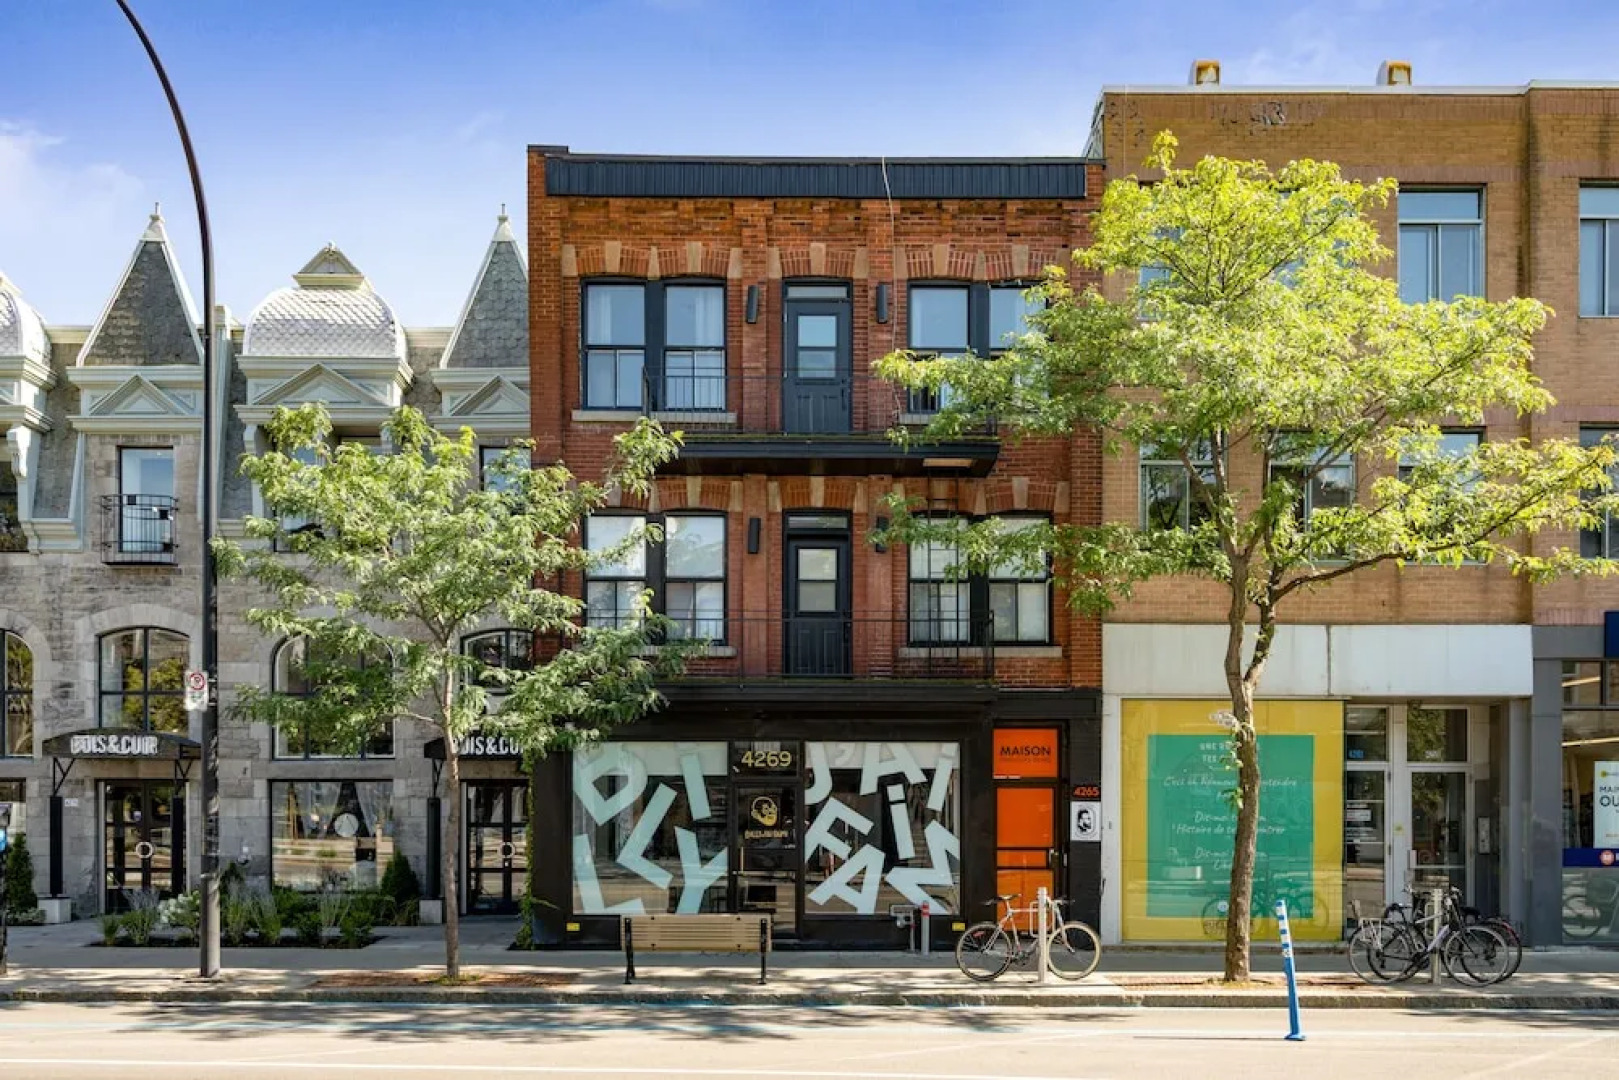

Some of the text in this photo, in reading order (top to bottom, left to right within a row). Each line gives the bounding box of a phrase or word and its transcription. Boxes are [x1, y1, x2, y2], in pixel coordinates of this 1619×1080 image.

[1000, 746, 1051, 757] MAISON
[740, 750, 793, 767] 4269
[1073, 786, 1100, 797] 4265
